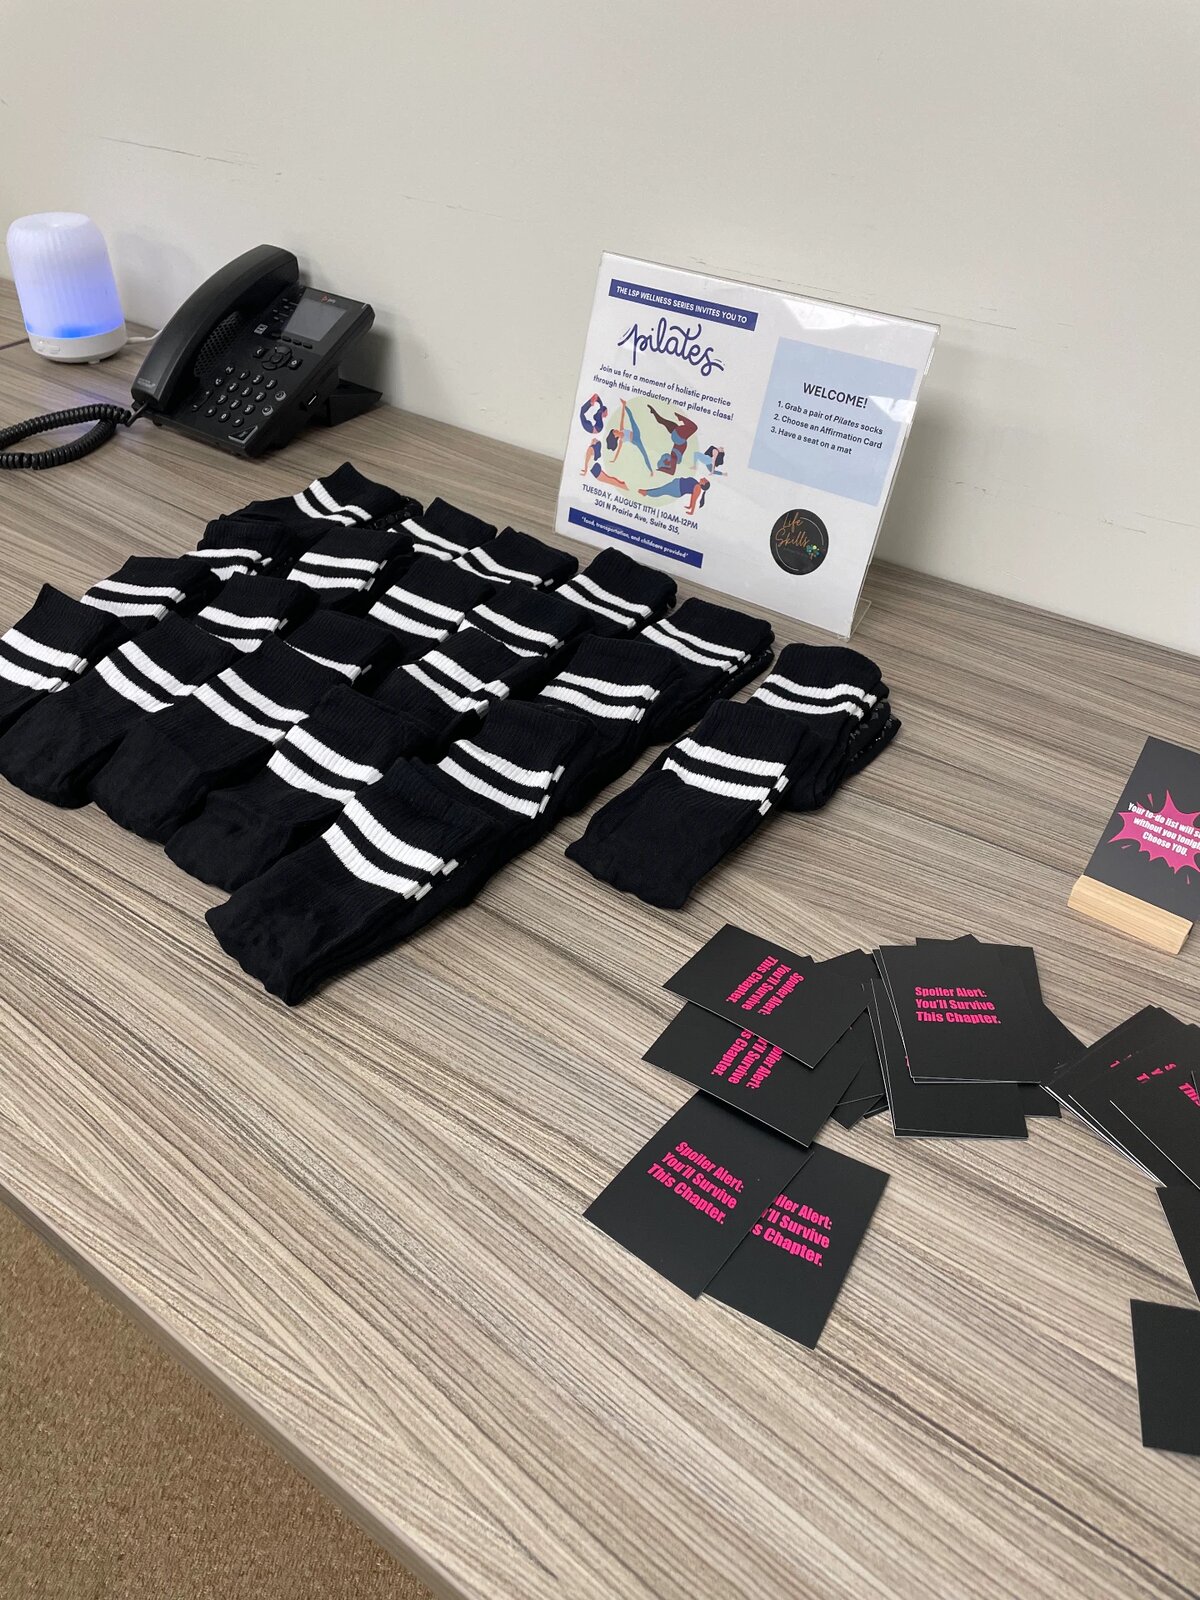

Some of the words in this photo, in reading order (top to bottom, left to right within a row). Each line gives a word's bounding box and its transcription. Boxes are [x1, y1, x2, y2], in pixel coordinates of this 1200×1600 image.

[617, 285, 628, 294] THE
[628, 288, 640, 298] LSP
[640, 291, 672, 306] WELLNESS
[672, 298, 694, 311] SERIES
[695, 304, 720, 317] INVITES
[722, 311, 737, 321] YOU
[737, 315, 748, 324] TO
[618, 317, 725, 376] pilates
[593, 374, 618, 388] through
[619, 382, 630, 391] this
[632, 385, 672, 404] introductory
[672, 398, 686, 407] mat
[686, 401, 712, 416] pilates
[712, 409, 734, 422] class!
[599, 364, 612, 374] Join
[622, 369, 632, 378] for
[639, 376, 666, 388] moment
[667, 382, 674, 390] of
[676, 384, 701, 398] holistic
[702, 393, 732, 408] practice
[803, 382, 868, 409] WELCOME!
[773, 414, 780, 422] 2.
[781, 416, 809, 430] Choose
[810, 423, 820, 432] an
[819, 424, 863, 444] Affirmation
[863, 435, 883, 450] Card
[777, 400, 784, 408] 1.
[784, 402, 802, 414] Grab
[808, 408, 824, 420] pair
[824, 411, 834, 422] of
[833, 415, 860, 430] Pilates
[860, 422, 884, 436] socks
[770, 426, 777, 434] 3.
[778, 428, 797, 440] Have
[802, 435, 819, 446] seat
[820, 440, 830, 448] on
[837, 444, 852, 455] mat
[582, 484, 613, 501] TUESDAY,
[614, 495, 641, 510] AUGUST
[642, 504, 656, 516] 11TH
[660, 511, 698, 530] 10AM-12PM
[594, 499, 605, 510] 301
[606, 503, 611, 511] N
[612, 504, 633, 518] Prairie
[634, 512, 648, 524] Ave,
[650, 518, 667, 530] Suite
[668, 524, 680, 535] 515,
[596, 522, 630, 539] transportation,
[630, 534, 640, 542] and
[640, 537, 664, 550] childcare
[1128, 802, 1146, 816] Your
[1145, 810, 1166, 824] to-do
[1165, 818, 1180, 830] list
[1179, 824, 1194, 835] will
[1134, 817, 1162, 834] without
[1162, 829, 1177, 840] you
[1142, 832, 1172, 849] Choose
[1172, 842, 1188, 857] YOU.
[756, 956, 779, 974] This
[766, 964, 792, 986] You'll
[726, 972, 763, 1003] Chapter.
[741, 982, 774, 1010] Survive
[776, 972, 804, 998] Spoiler
[914, 985, 954, 1000] Spoiler
[955, 986, 988, 998] Alert:
[758, 996, 783, 1016] Alert:
[915, 998, 948, 1012] You'll
[949, 998, 996, 1012] Survive
[916, 1011, 944, 1023] This
[945, 1012, 1002, 1025] Chapter.
[710, 1038, 748, 1076] Chapter.
[728, 1050, 761, 1084] Survive
[763, 1045, 784, 1068] oiler
[746, 1065, 772, 1089] Alert:
[661, 1152, 693, 1180] You'll
[692, 1172, 738, 1210] Survive
[675, 1141, 716, 1175] Spoiler
[713, 1166, 744, 1194] Alert:
[647, 1163, 675, 1188] This
[674, 1181, 726, 1225] Chapter.
[780, 1215, 830, 1248] Survive
[798, 1204, 832, 1230] Alert:
[763, 1228, 823, 1267] Chapter.
